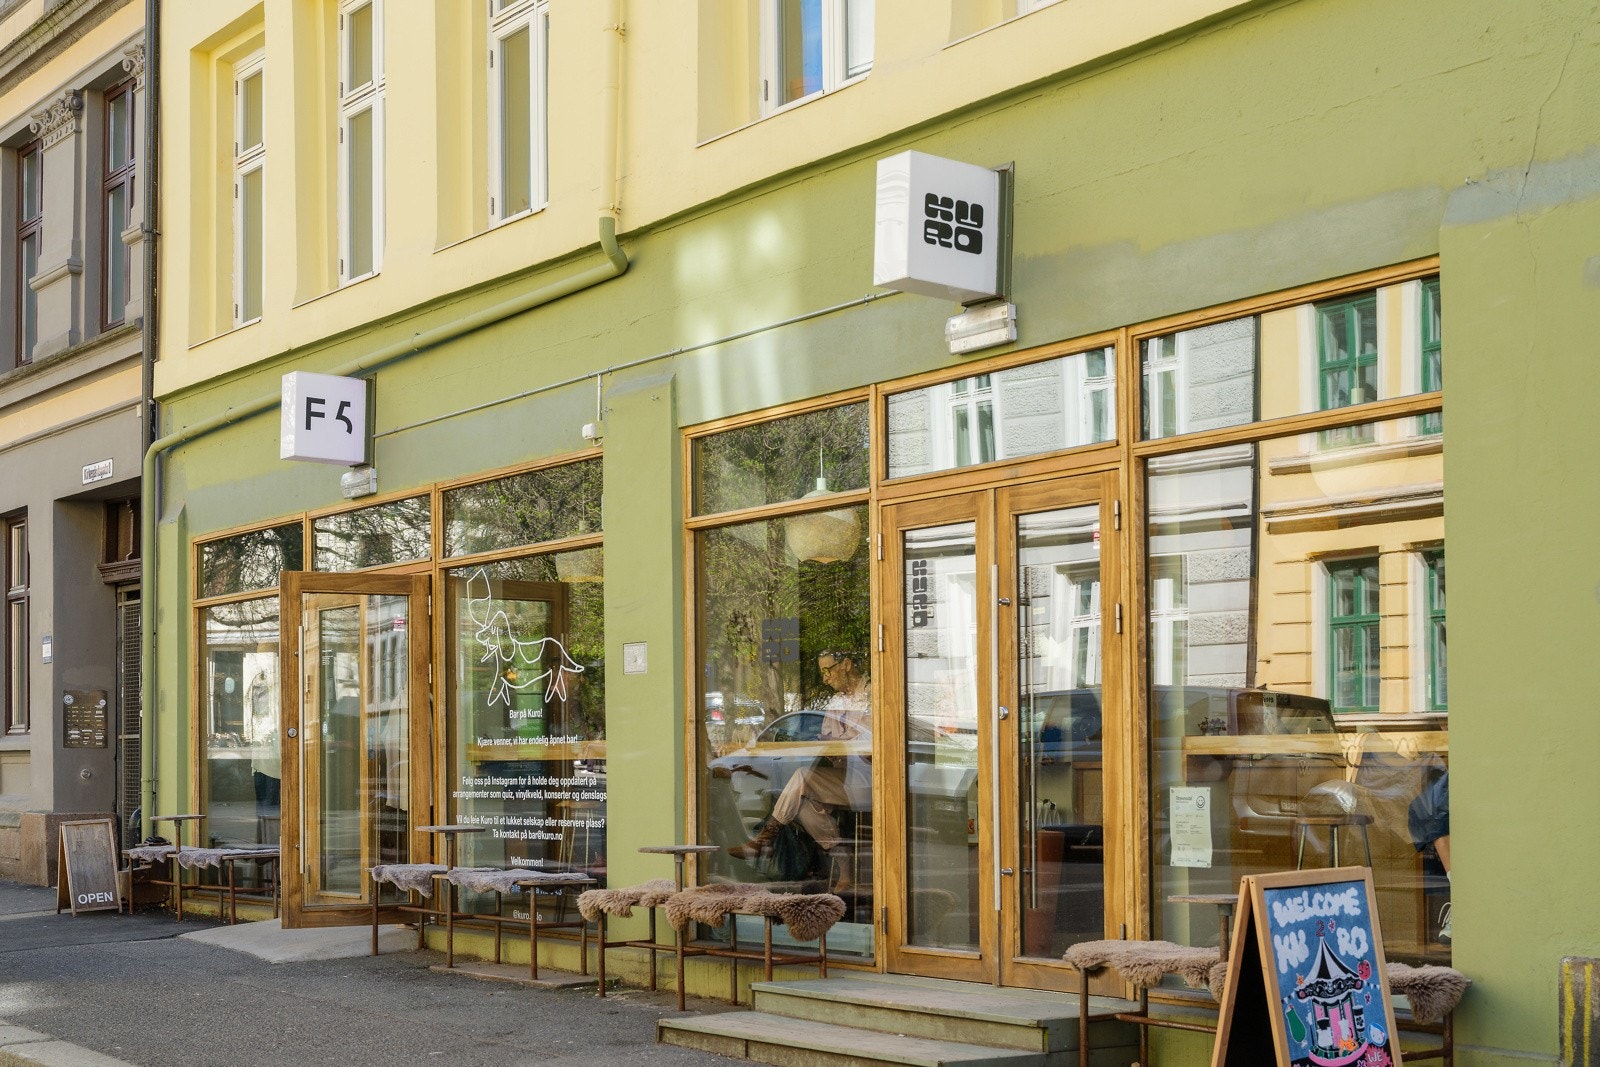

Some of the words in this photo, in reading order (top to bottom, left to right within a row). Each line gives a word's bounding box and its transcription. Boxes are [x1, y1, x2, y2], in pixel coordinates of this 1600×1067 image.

[510, 710, 518, 718] Bar
[520, 708, 526, 720] på
[528, 708, 542, 718] Kuro!
[478, 737, 492, 748] Kjære
[494, 738, 512, 746] venner,
[514, 736, 518, 744] vi
[518, 736, 528, 744] har
[528, 736, 548, 746] endelig
[550, 735, 566, 746] åpnet
[566, 734, 578, 744] bar!
[462, 776, 474, 786] Følg
[484, 776, 490, 786] på
[492, 776, 518, 787] Instagram
[518, 776, 526, 785] for
[528, 776, 531, 786] å
[532, 776, 547, 786] holde
[548, 776, 560, 787] deg
[560, 776, 588, 788] oppdatert
[588, 776, 596, 787] på
[452, 790, 489, 800] arrangementer
[502, 790, 514, 800] quiz,
[516, 790, 544, 800] vinylkveld,
[544, 790, 571, 799] konserter
[572, 792, 580, 802] og
[580, 790, 607, 802] denslags
[464, 816, 470, 824] du
[470, 815, 480, 824] leie
[480, 816, 494, 825] Kuro
[500, 816, 506, 824] et
[506, 816, 522, 826] lukket
[523, 817, 544, 828] selskap
[545, 817, 557, 826] eller
[558, 820, 584, 828] reservere
[586, 818, 605, 830] plass?
[492, 828, 498, 838] Ta
[500, 829, 520, 839] kontakt
[520, 829, 528, 840] på
[528, 830, 562, 840] bar@kuro.no
[510, 856, 544, 867] Velkommen!
[78, 892, 114, 904] OPEN
[1272, 887, 1360, 928] WELCOME
